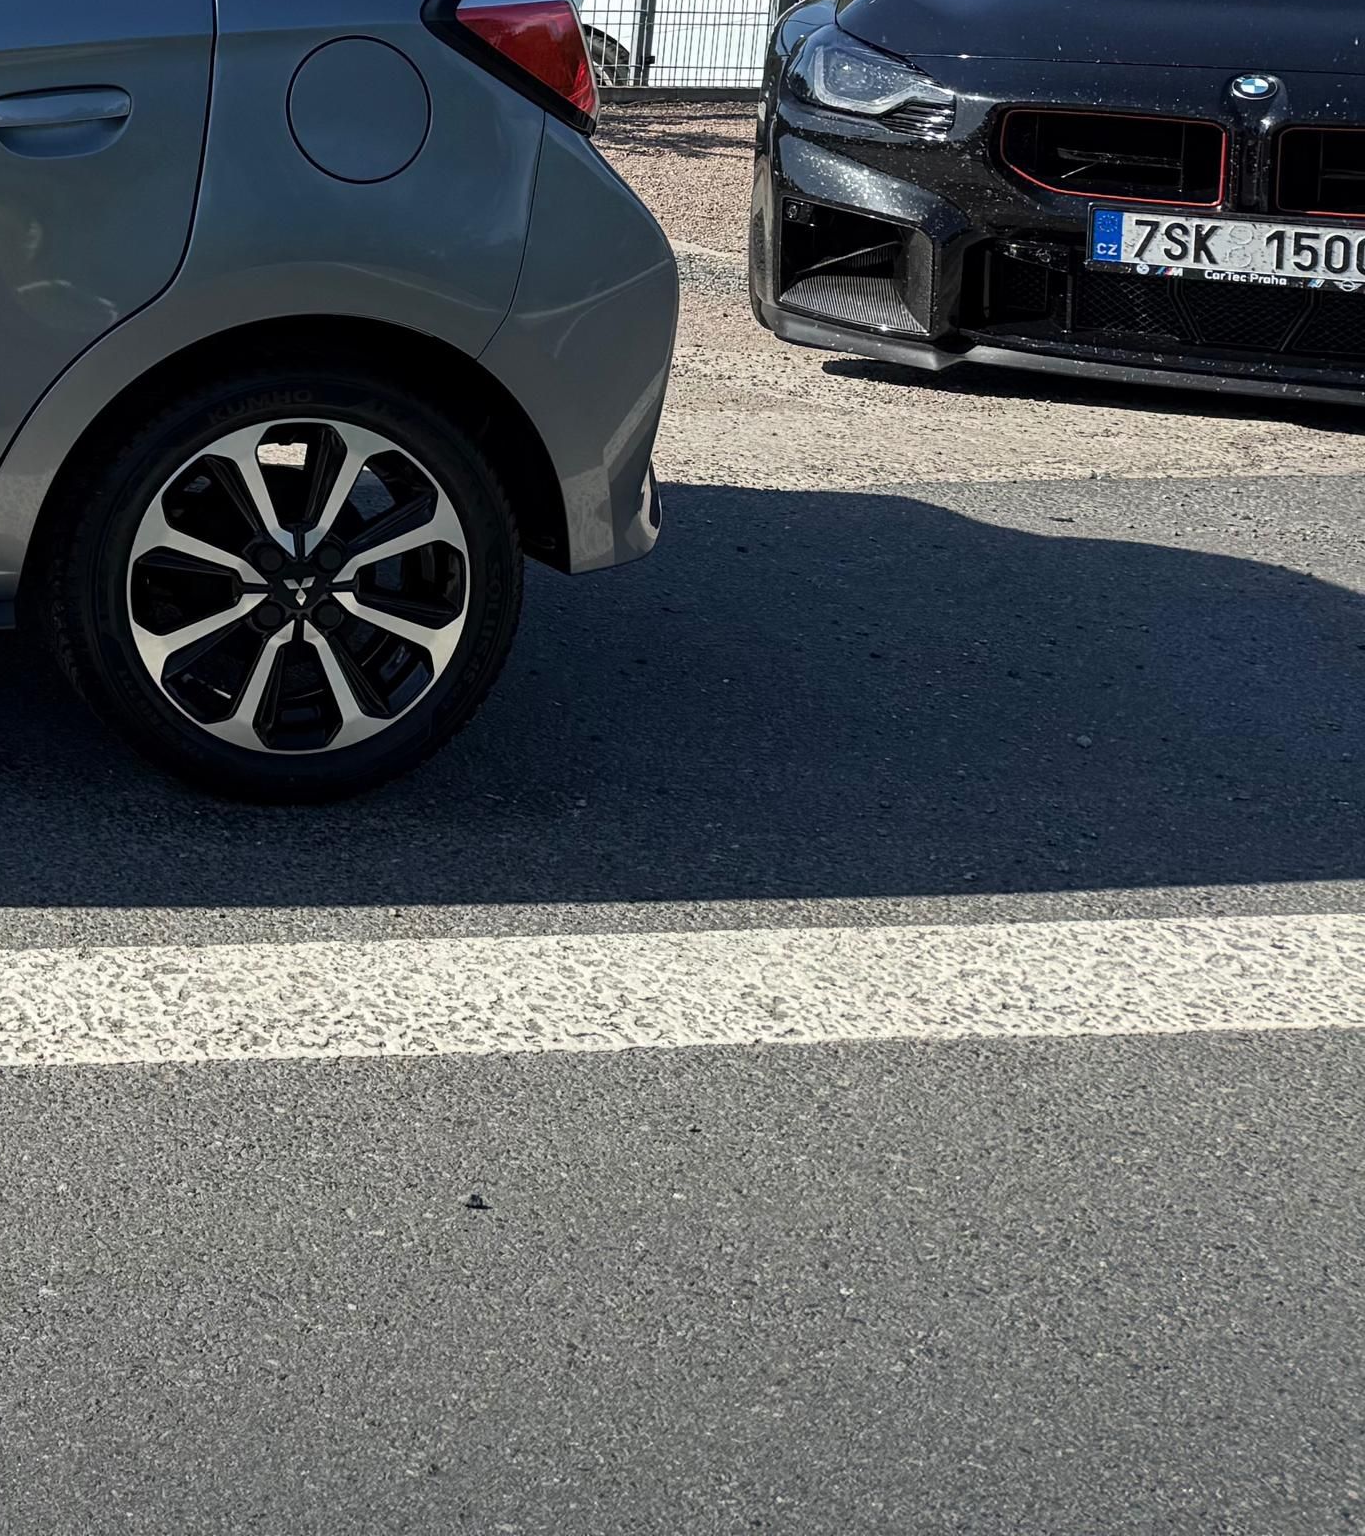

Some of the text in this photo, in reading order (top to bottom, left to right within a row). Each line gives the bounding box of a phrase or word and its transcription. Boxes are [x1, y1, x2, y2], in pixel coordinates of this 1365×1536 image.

[1096, 242, 1118, 256] CZ
[1133, 219, 1219, 265] 7SK
[1204, 269, 1288, 286] CarTec Praha
